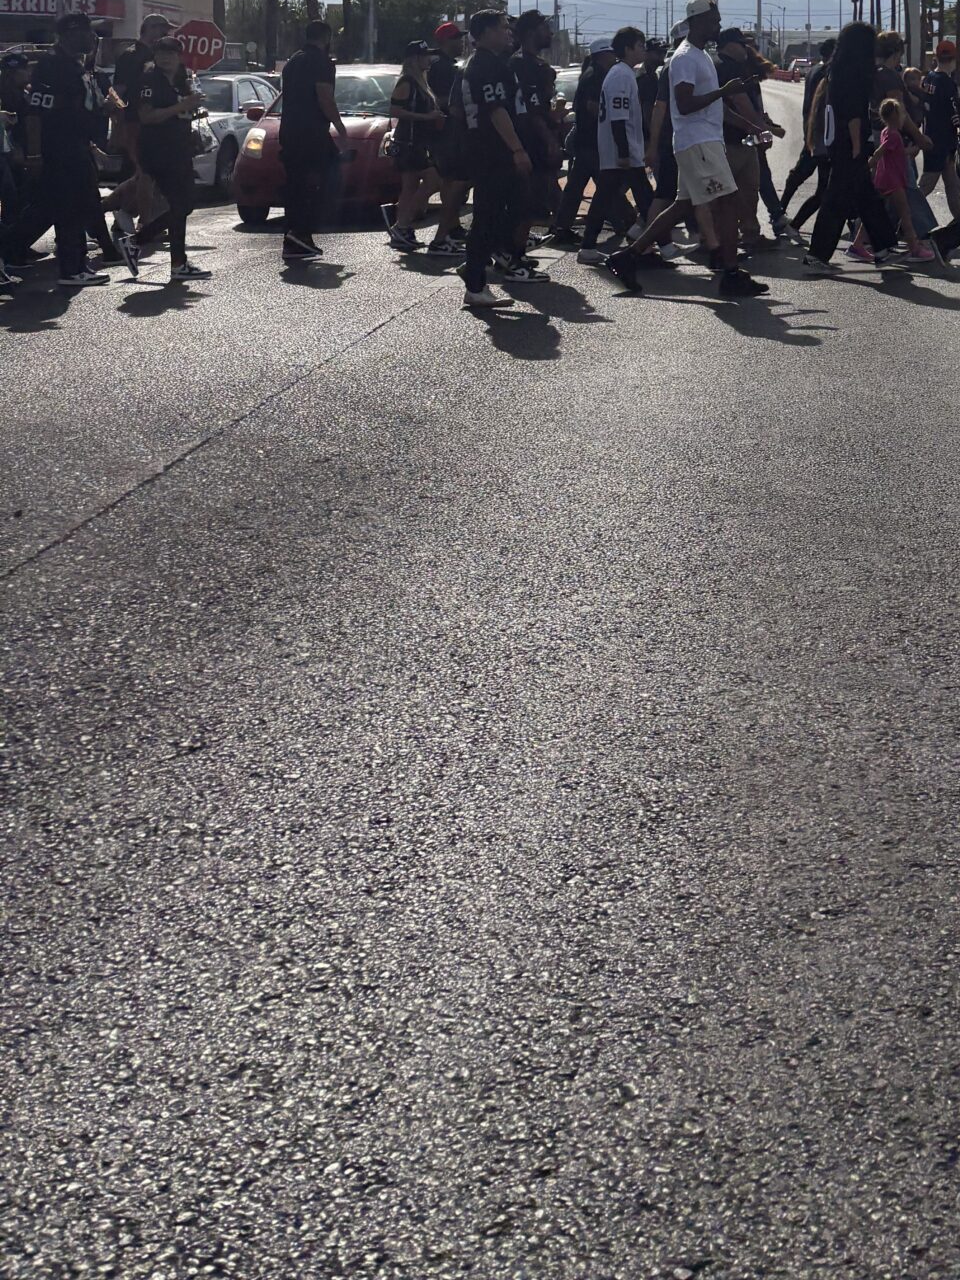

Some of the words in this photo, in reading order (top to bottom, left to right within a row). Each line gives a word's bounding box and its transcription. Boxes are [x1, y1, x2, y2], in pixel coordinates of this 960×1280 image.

[177, 34, 223, 56] STOP
[30, 92, 55, 109] 60
[483, 82, 507, 103] 24
[613, 97, 629, 109] 98
